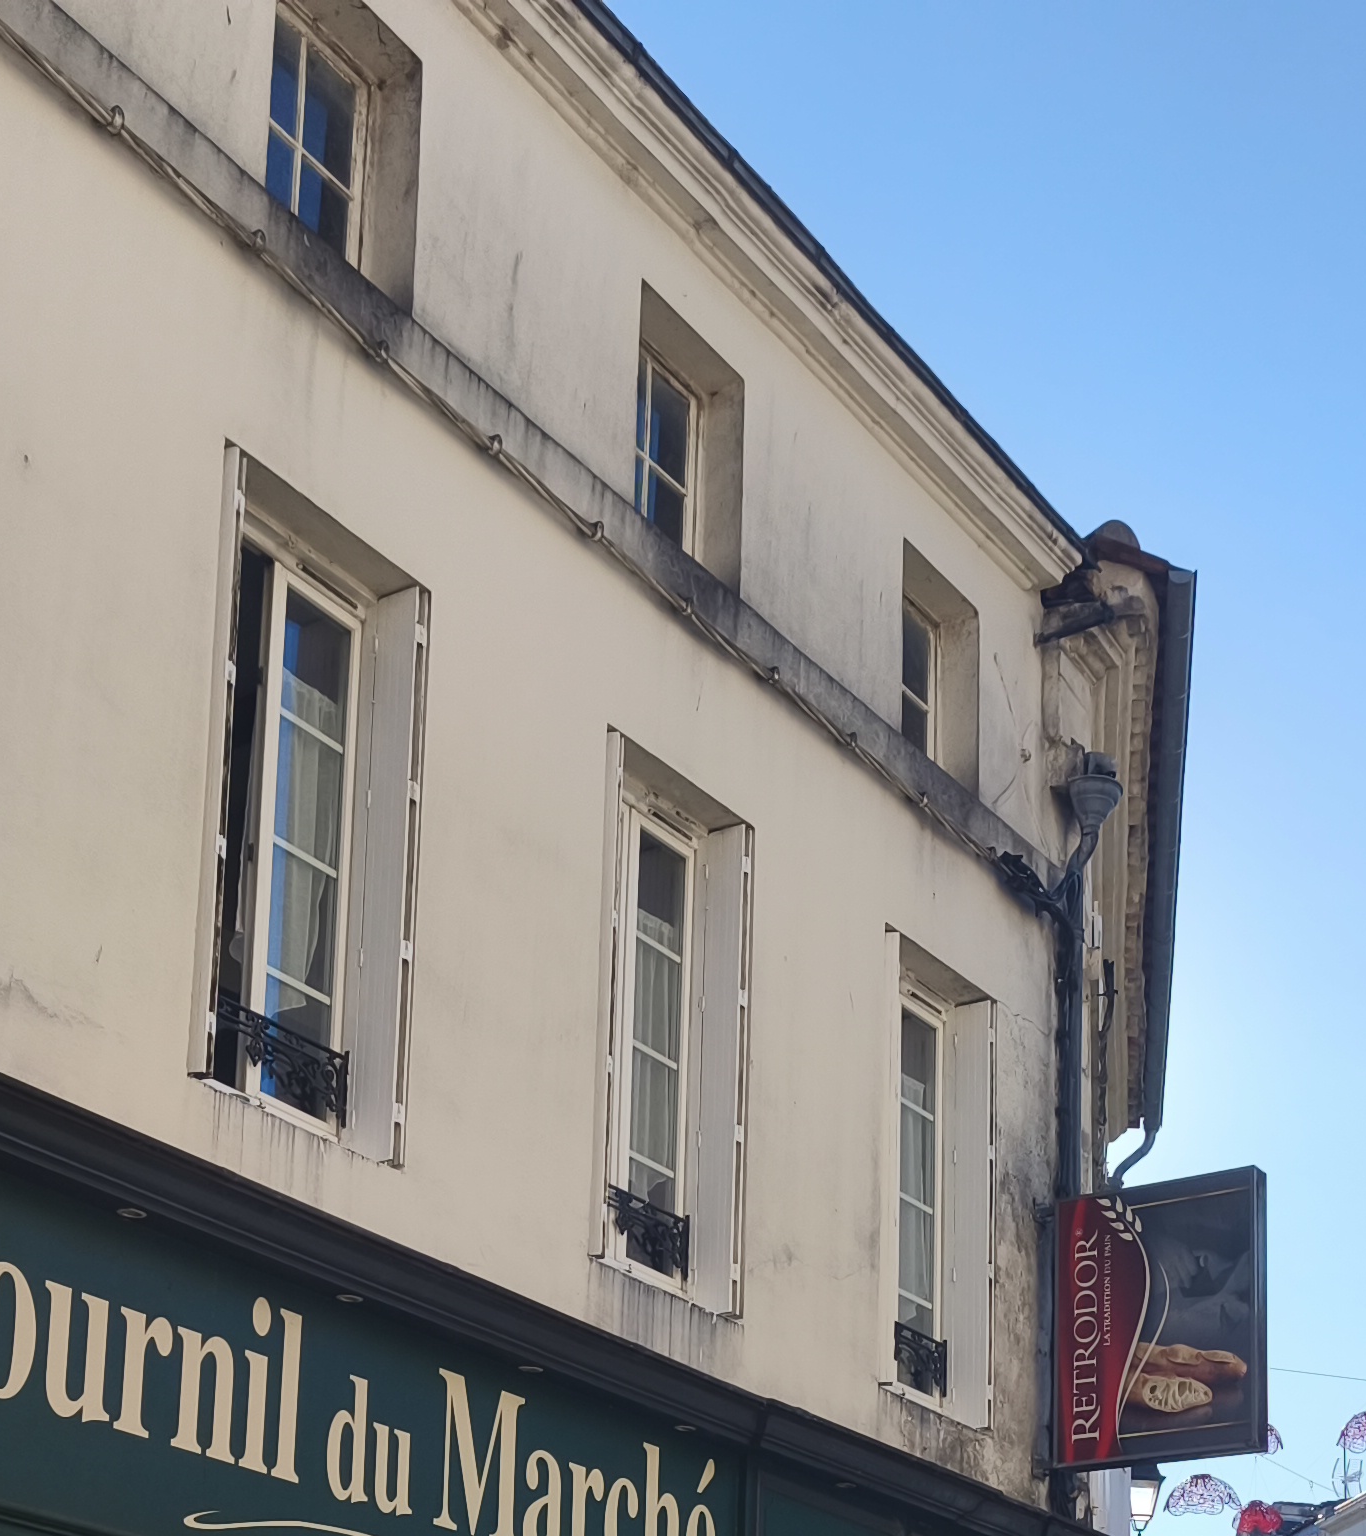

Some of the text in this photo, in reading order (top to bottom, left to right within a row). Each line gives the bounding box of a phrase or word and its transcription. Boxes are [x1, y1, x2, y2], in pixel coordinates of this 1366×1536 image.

[1104, 1259, 1111, 1273] DU
[1103, 1276, 1111, 1332] TRADITION
[1103, 1332, 1111, 1346] LA
[325, 1374, 412, 1518] du
